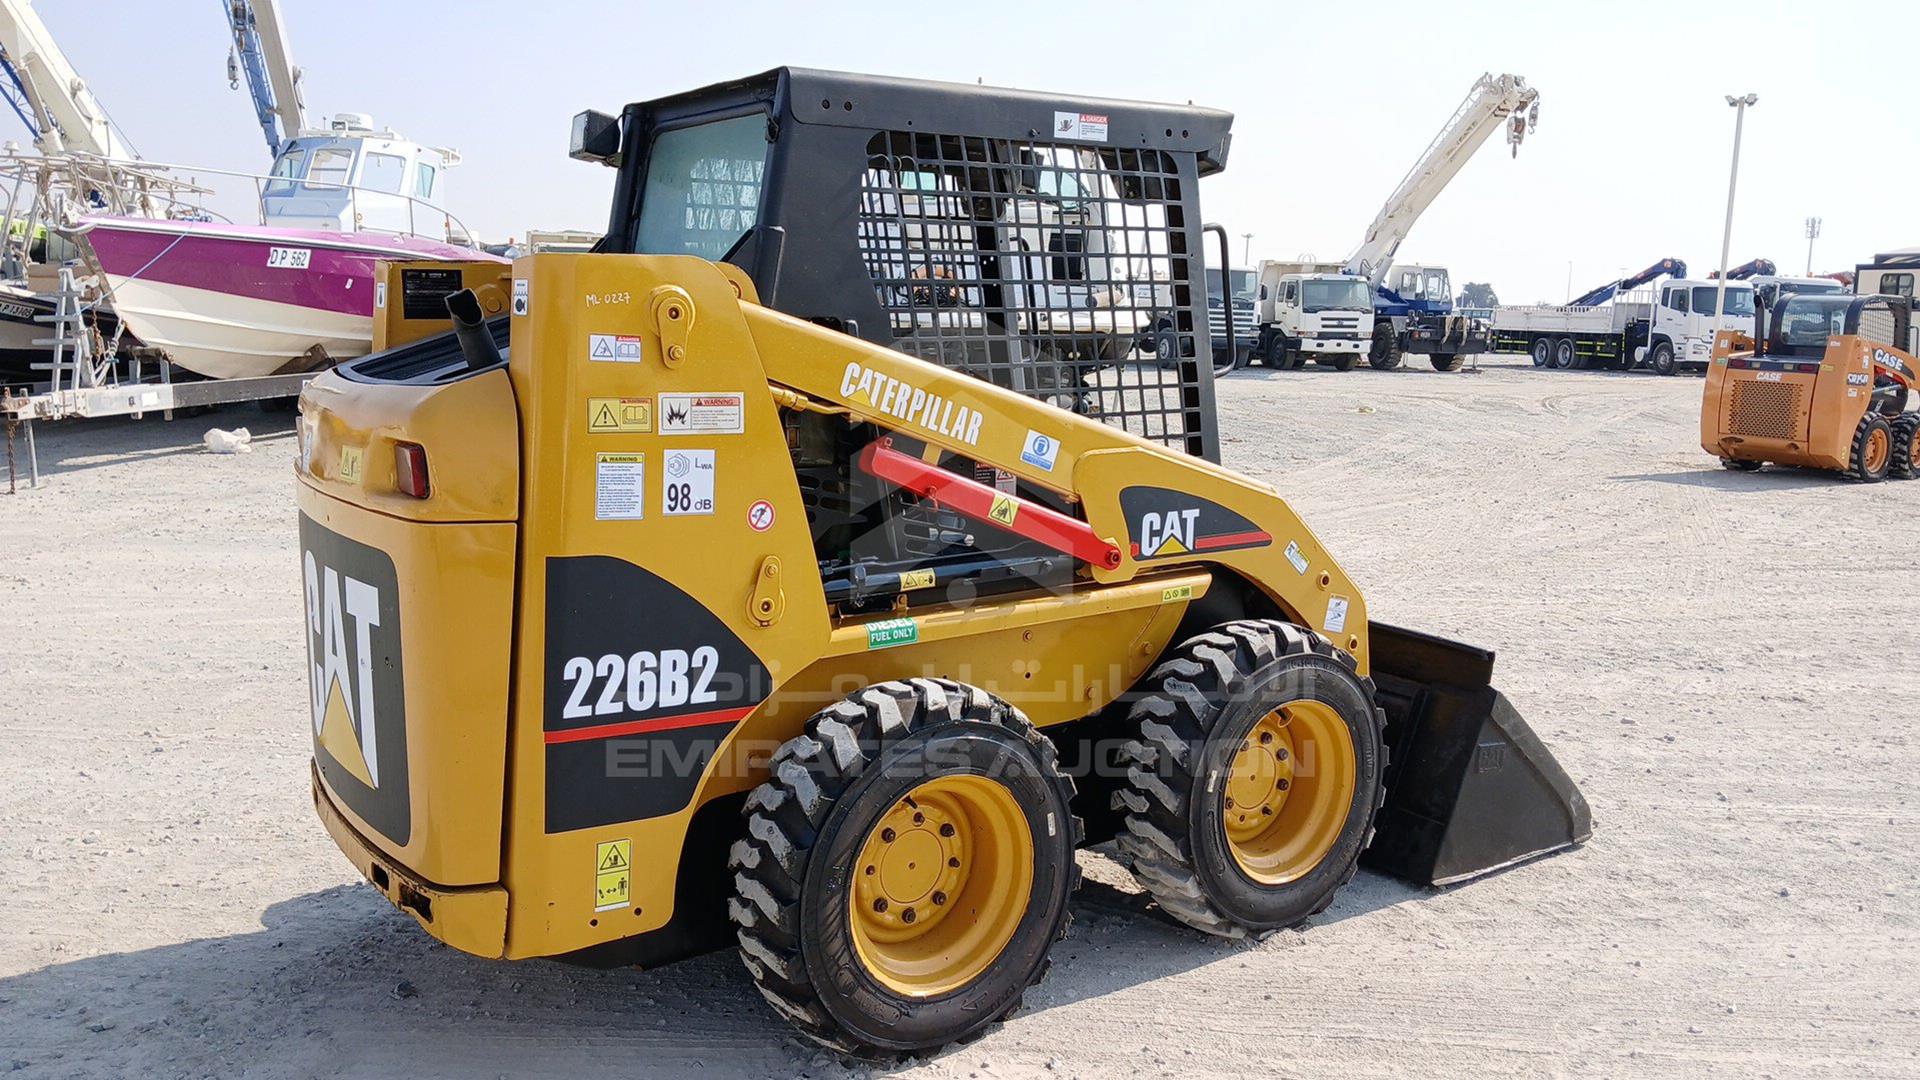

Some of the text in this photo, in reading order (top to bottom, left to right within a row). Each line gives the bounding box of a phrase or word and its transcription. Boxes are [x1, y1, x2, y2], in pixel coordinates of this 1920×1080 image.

[270, 249, 307, 266] D P 562
[1874, 349, 1905, 371] CASE
[1756, 372, 1782, 382] CASE
[840, 362, 984, 446] CATERPILLAR
[667, 483, 712, 512] 98 dB
[1141, 508, 1200, 557] CAT
[868, 617, 914, 632] DIESEL
[871, 627, 914, 643] FUEL ONLY
[305, 550, 379, 788] CAT
[563, 645, 719, 719] 226B2
